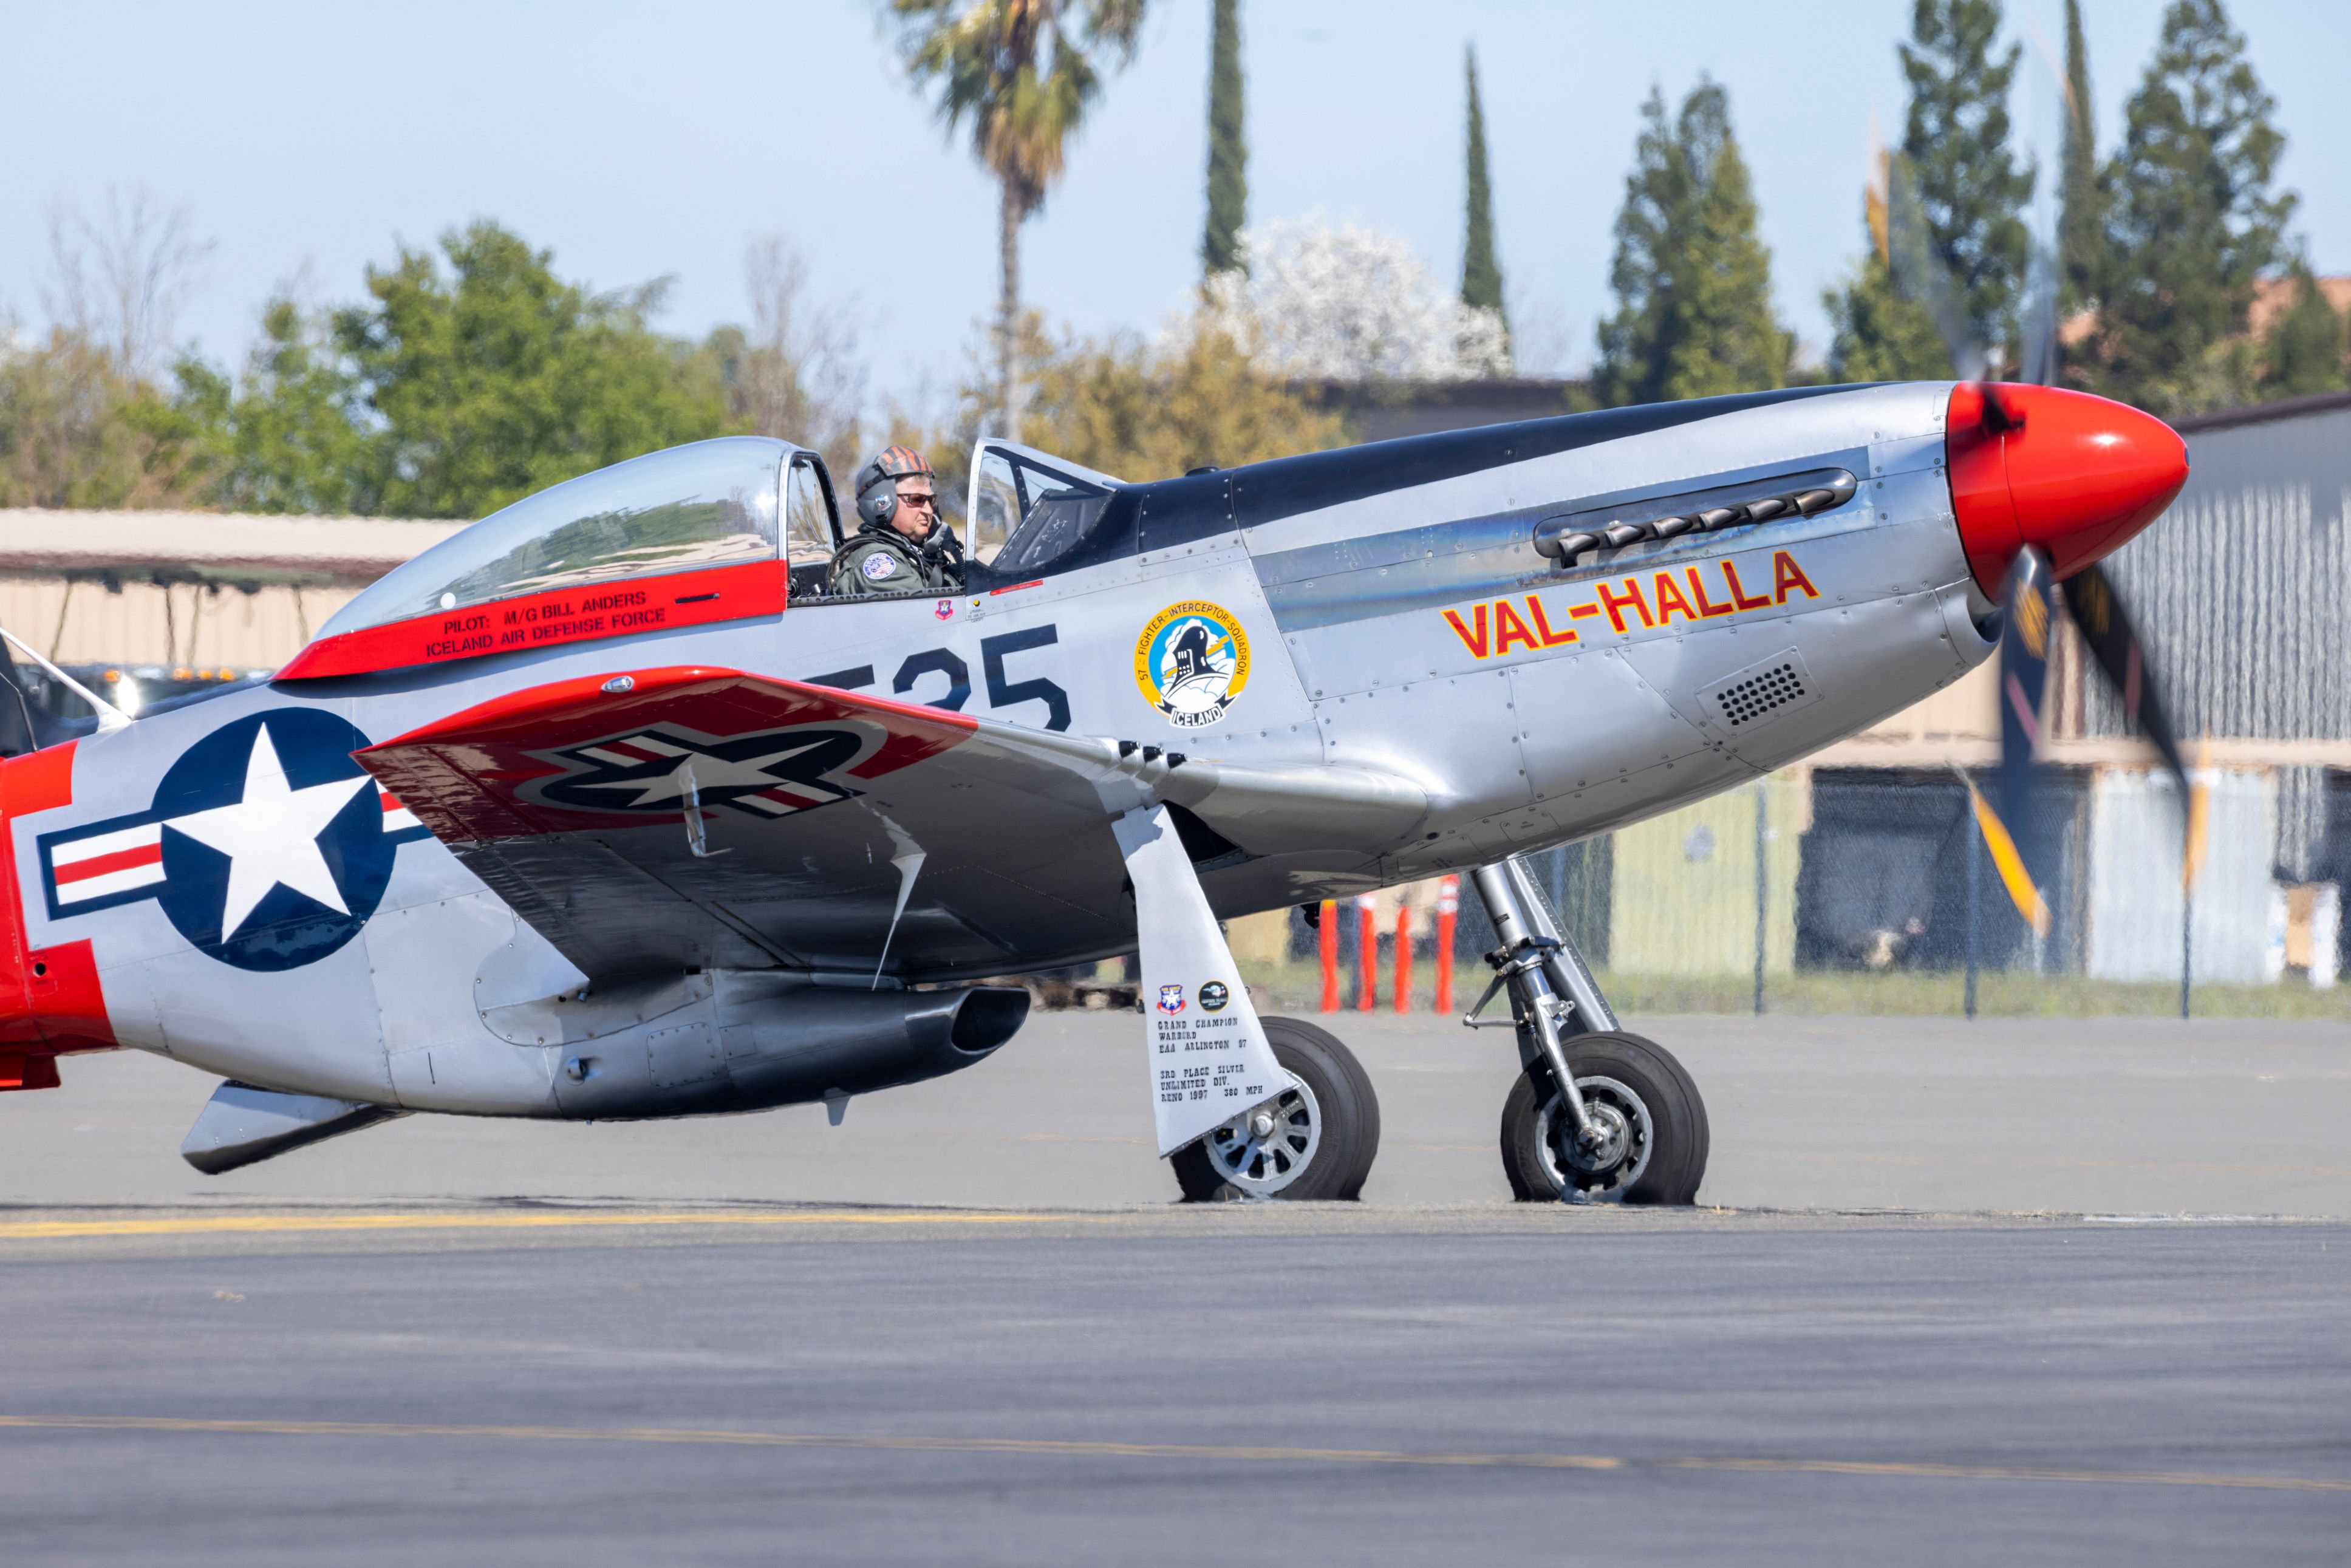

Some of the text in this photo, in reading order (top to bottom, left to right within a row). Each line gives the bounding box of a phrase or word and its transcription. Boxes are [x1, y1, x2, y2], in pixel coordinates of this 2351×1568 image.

[1441, 549, 1821, 660] VAL-HALLA
[445, 591, 646, 635] PILOT: M/G BILL ANDERS
[427, 608, 666, 656] ICELAND AIR DEFENSE FORCE
[1172, 707, 1221, 726] ICELAND
[1158, 1017, 1238, 1030] GRAND CHAMPION
[1159, 1032, 1196, 1040] WARBIRD
[1159, 1043, 1175, 1054] EAA
[1185, 1040, 1229, 1051] ARLINGTON
[1184, 1067, 1209, 1077] PLACE
[1218, 1064, 1244, 1074] SILVER
[1161, 1076, 1230, 1091] UNLIMITED DIV.
[1161, 1085, 1263, 1102] RENO 1997 380 MPH
